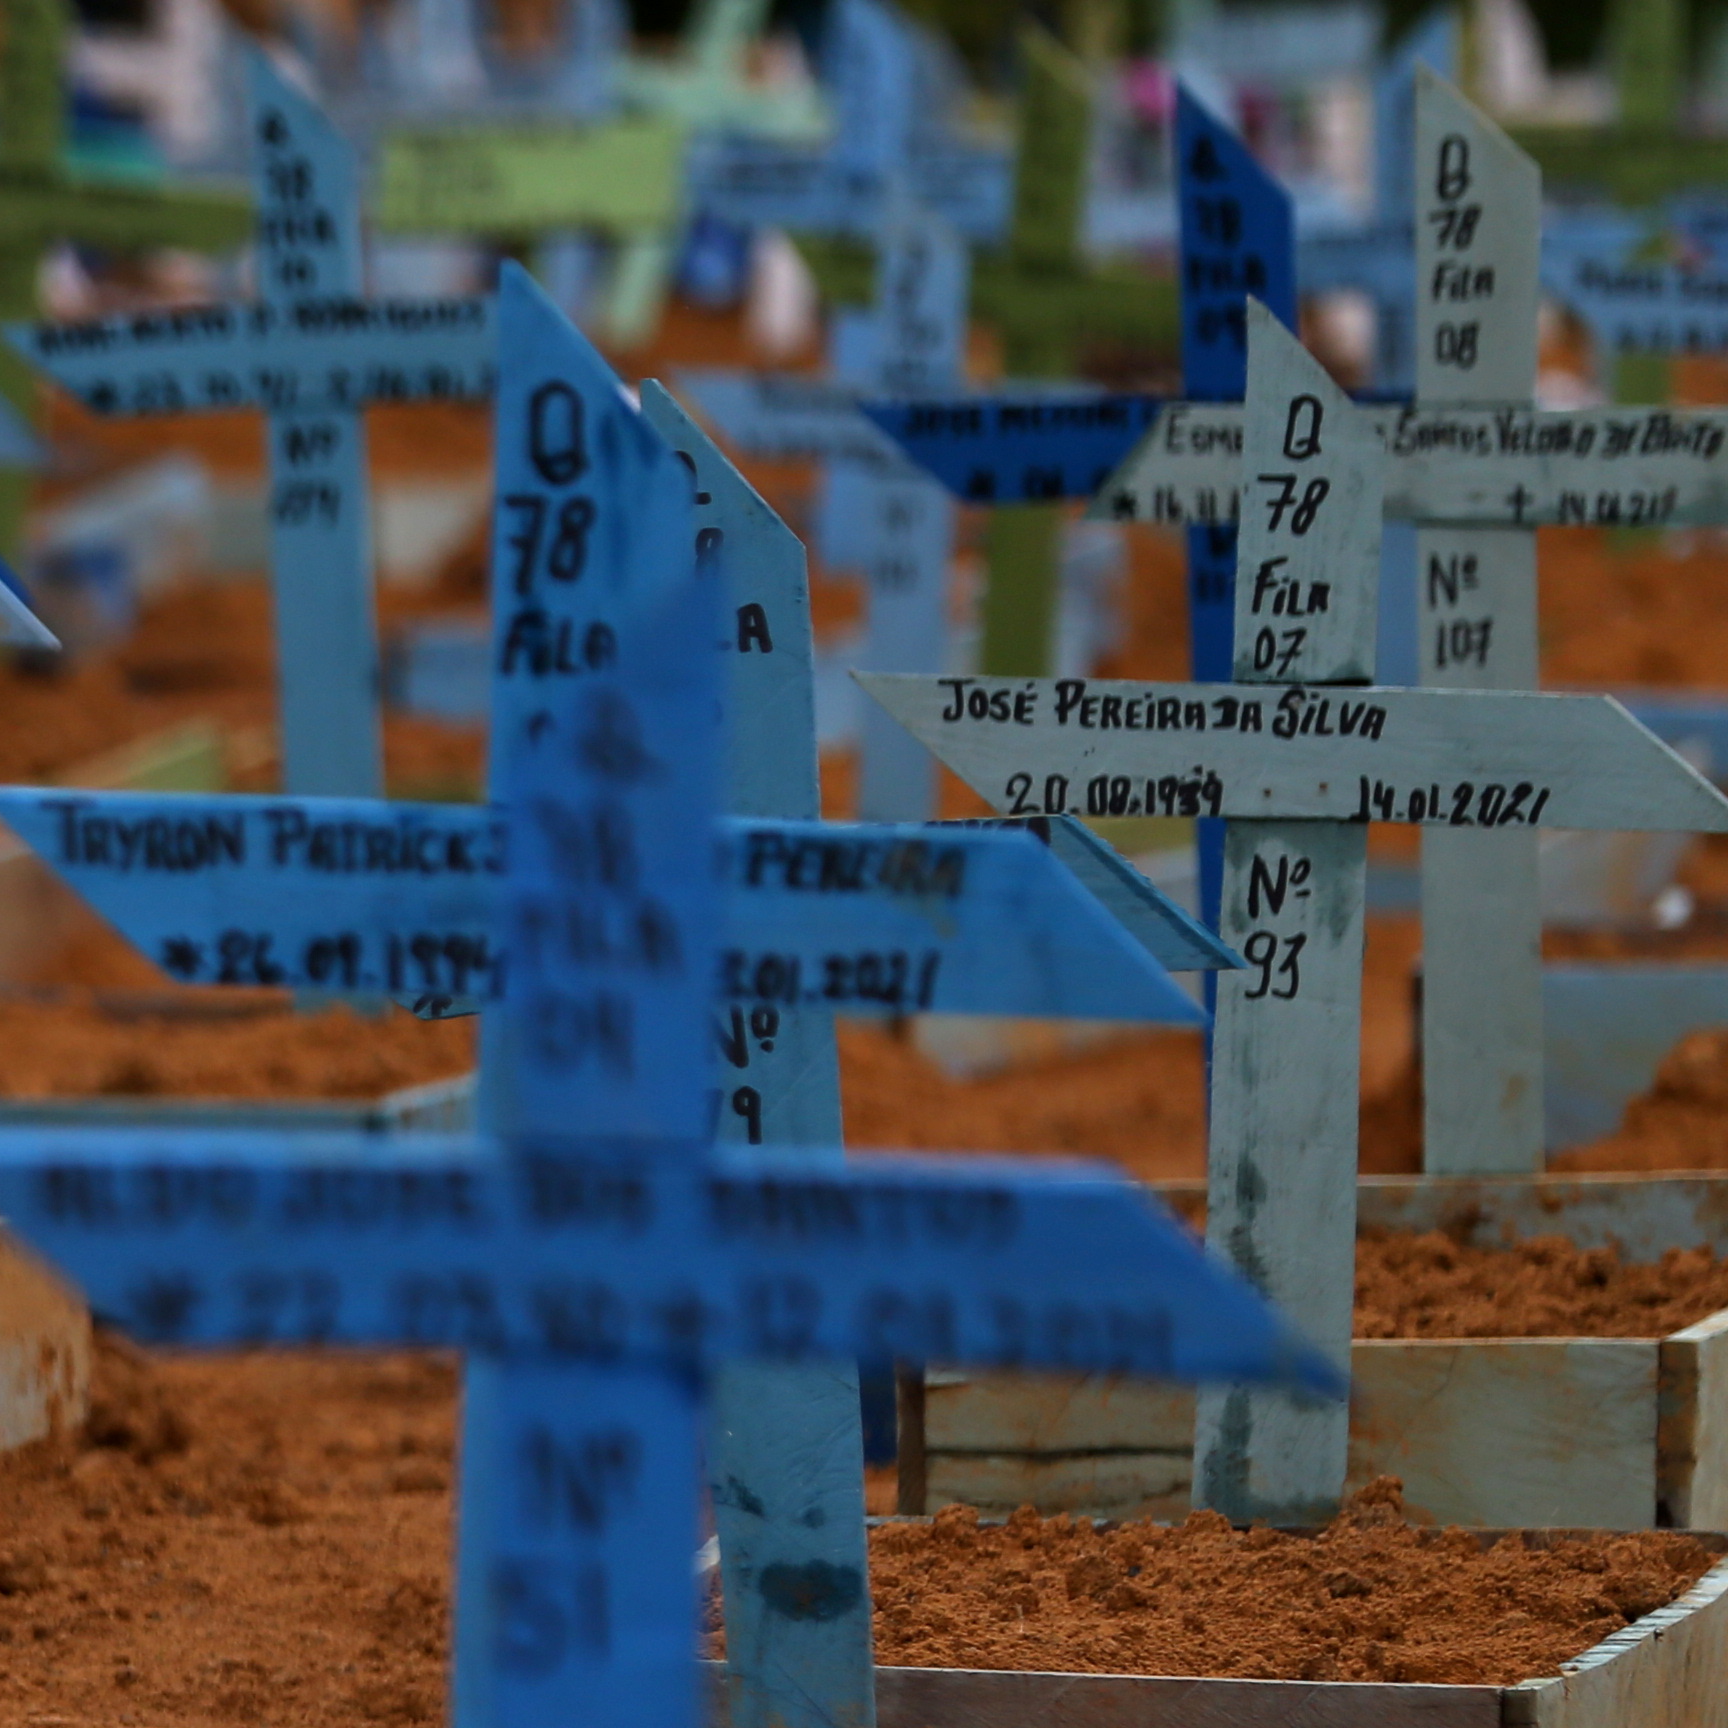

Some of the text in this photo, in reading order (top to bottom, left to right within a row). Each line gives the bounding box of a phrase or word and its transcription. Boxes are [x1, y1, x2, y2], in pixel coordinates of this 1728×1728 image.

[528, 379, 591, 488] Q
[1282, 394, 1324, 460] Q
[1256, 472, 1331, 537] 78
[503, 494, 597, 600] 78
[1253, 626, 1308, 677] 07
[937, 677, 1038, 726] JOSÉ
[1243, 930, 1308, 1001] 93
